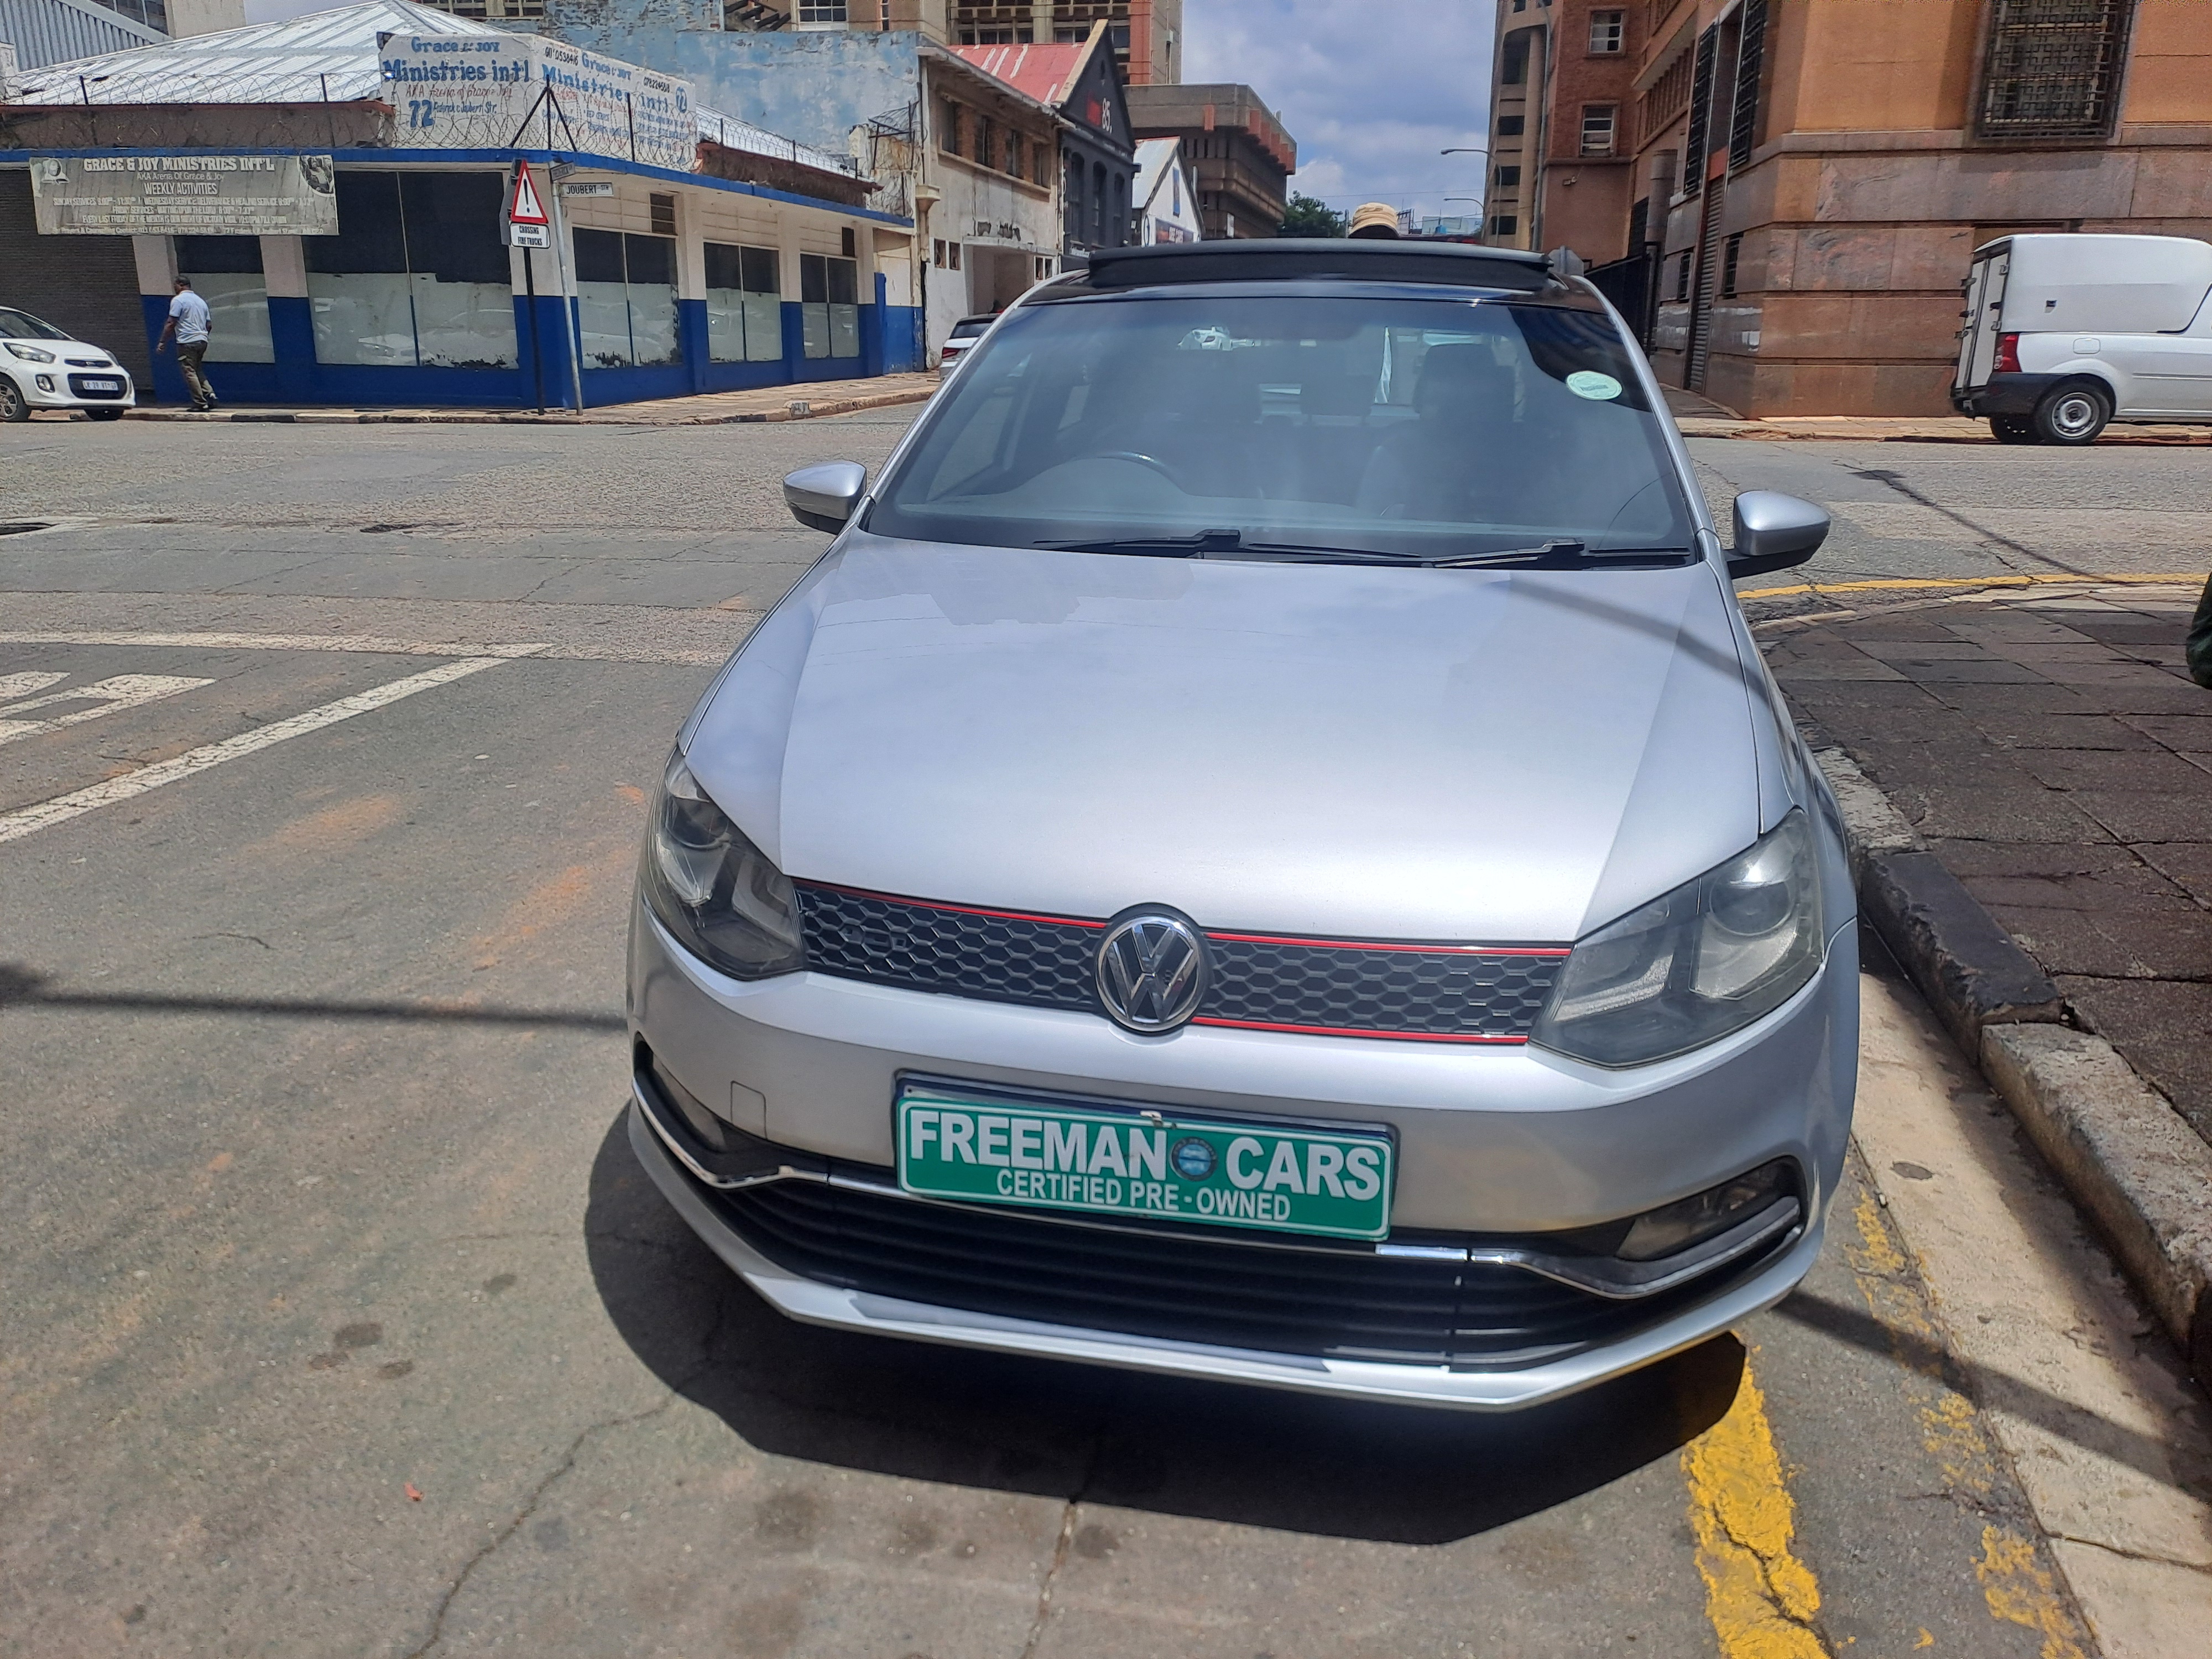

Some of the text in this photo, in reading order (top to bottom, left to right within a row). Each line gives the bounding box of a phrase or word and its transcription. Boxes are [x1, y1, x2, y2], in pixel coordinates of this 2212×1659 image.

[411, 36, 458, 53] Grace
[383, 59, 487, 82] Ministries
[409, 100, 436, 128] 72
[84, 157, 275, 172] GRACE & JOY MINISTRIES INT'L
[144, 182, 218, 195] WEEKLY ACTIVITIES
[567, 185, 597, 194] JOUBERT
[519, 225, 539, 234] CROSSING
[518, 236, 542, 246] FIRE TRUCKS
[910, 1110, 1381, 1201] FREEMAN CARS
[996, 1168, 1123, 1208] CERTIFIED
[1129, 1180, 1180, 1212] PRE
[1196, 1187, 1292, 1222] OWNED
